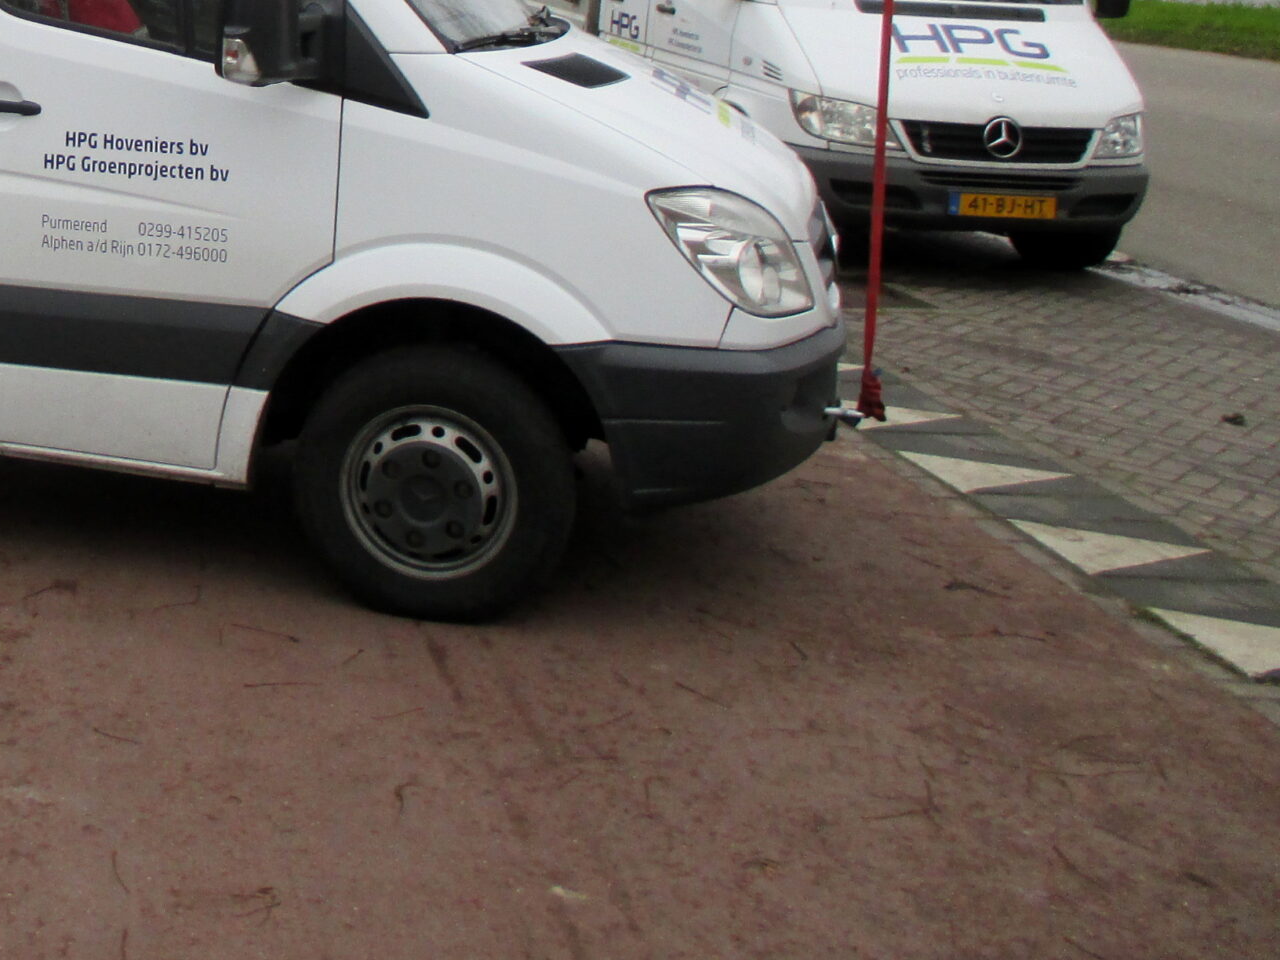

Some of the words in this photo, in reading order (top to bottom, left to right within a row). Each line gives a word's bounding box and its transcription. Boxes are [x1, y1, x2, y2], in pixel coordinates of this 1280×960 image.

[610, 9, 640, 40] HPG
[891, 23, 1051, 60] HPG
[895, 66, 983, 81] professionals
[984, 69, 996, 79] in
[65, 130, 98, 149] HPG
[103, 133, 184, 155] Hoveniers
[189, 138, 209, 156] bv
[43, 153, 76, 171] HPG
[81, 156, 205, 181] Groenprojecten
[209, 164, 230, 182] bv
[967, 196, 1047, 216] 41-BJ-HT
[41, 214, 108, 233] Purmerend
[138, 222, 229, 243] 0299-415205
[41, 234, 84, 251] Alphen
[86, 238, 108, 254] a/d
[111, 240, 134, 258] Rijn
[137, 242, 228, 263] 0172-496000
